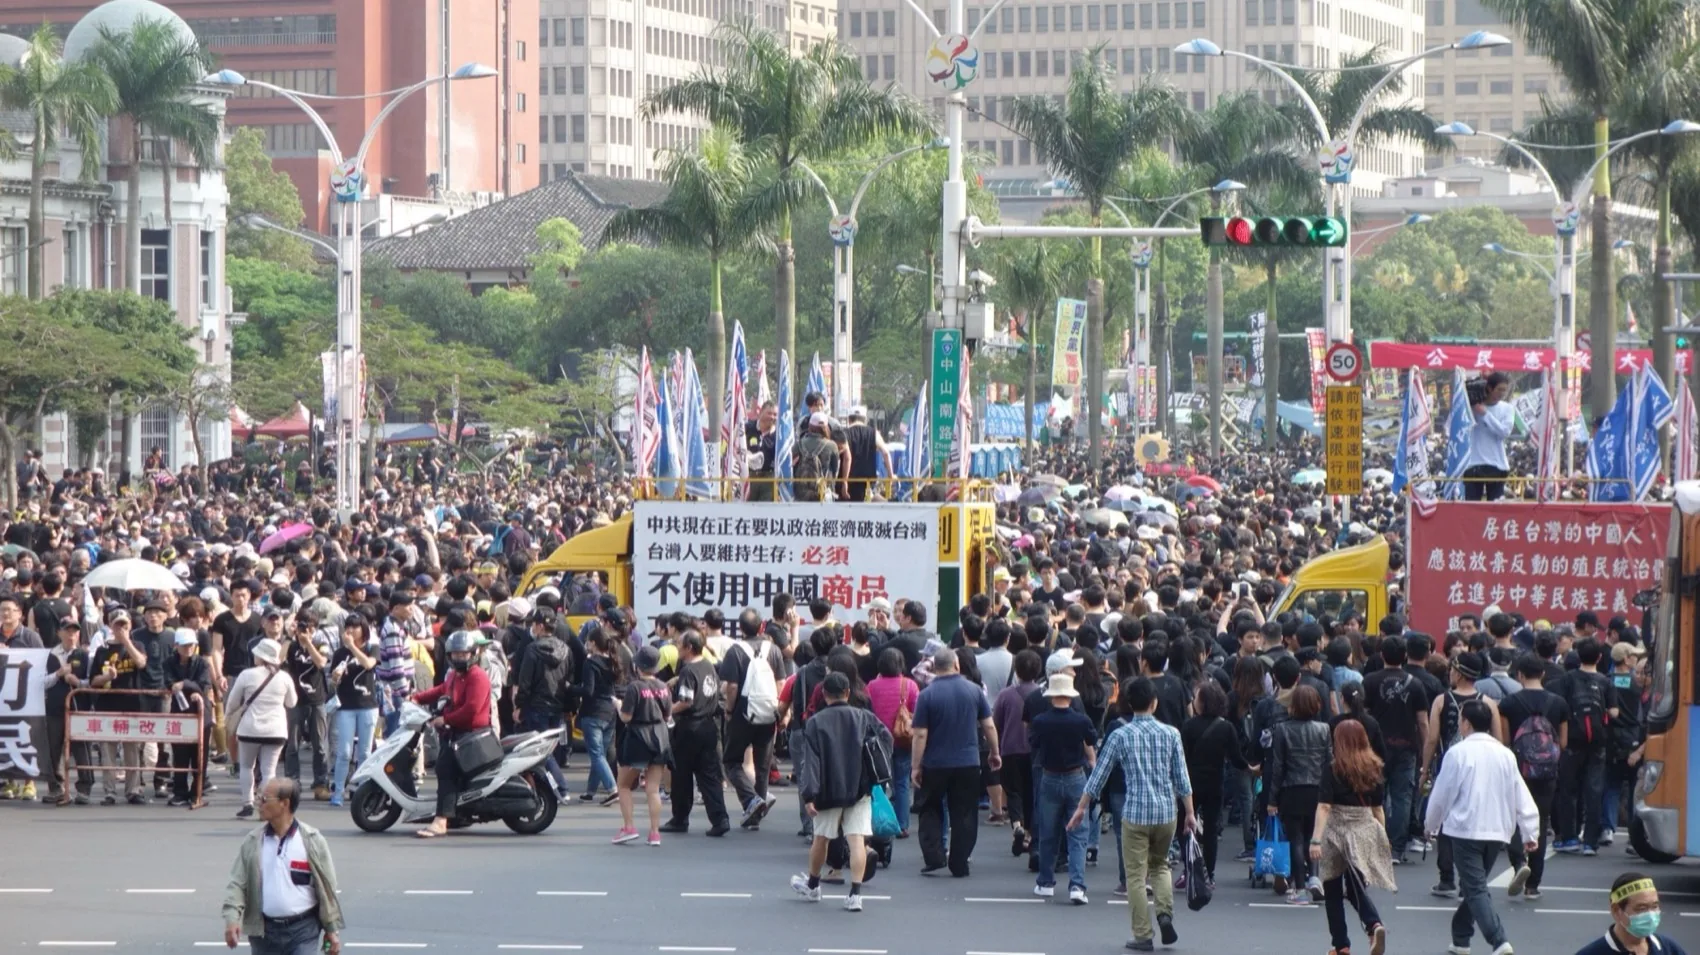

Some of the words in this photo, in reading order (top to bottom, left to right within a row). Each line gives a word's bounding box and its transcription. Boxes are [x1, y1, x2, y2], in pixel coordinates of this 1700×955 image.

[1332, 355, 1355, 369] 50
[939, 357, 953, 440] 中山南路
[1330, 390, 1344, 491] 請依速限行駛
[1346, 390, 1360, 491] 前有測速照相
[647, 516, 928, 541] 中共現在正在要以政治經濟破滅台灣
[647, 572, 890, 611] 不使用中國商品
[86, 719, 183, 736] 車輛改道
